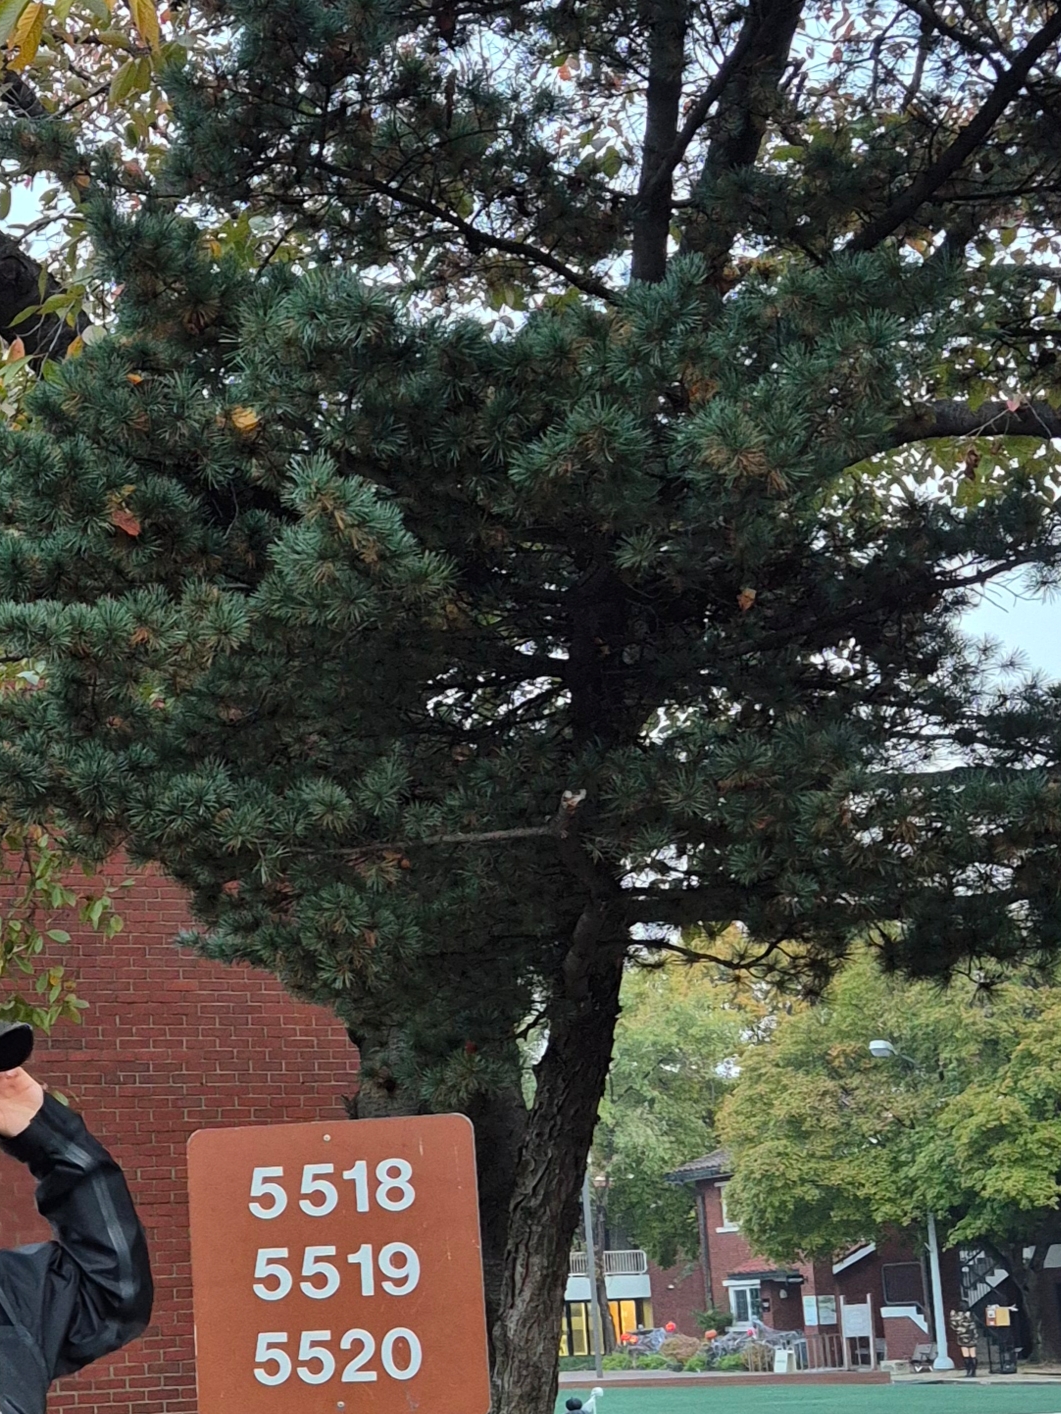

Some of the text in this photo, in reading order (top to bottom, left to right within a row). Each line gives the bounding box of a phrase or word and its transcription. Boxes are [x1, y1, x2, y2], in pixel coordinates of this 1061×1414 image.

[248, 1157, 416, 1220] 5518
[252, 1241, 421, 1301] 5519
[253, 1326, 423, 1386] 5520
